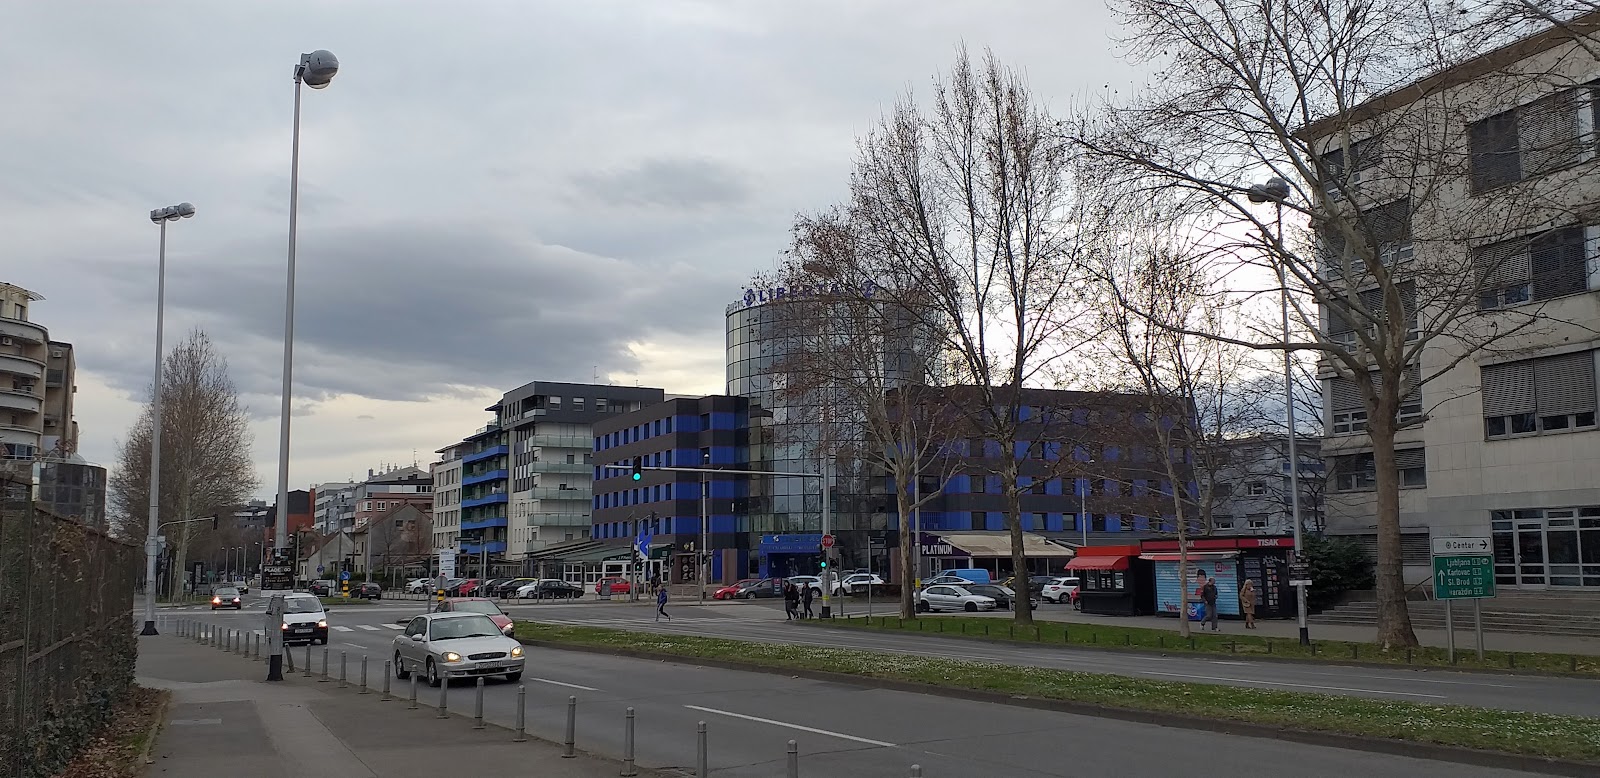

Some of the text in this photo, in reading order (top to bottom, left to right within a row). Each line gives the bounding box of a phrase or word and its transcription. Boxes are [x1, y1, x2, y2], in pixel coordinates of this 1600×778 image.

[1258, 539, 1279, 547] TISAK
[1452, 541, 1475, 549] Centar
[922, 545, 953, 555] PLATINUM
[1446, 559, 1471, 568] Ljubljana
[1456, 578, 1471, 586] Brod
